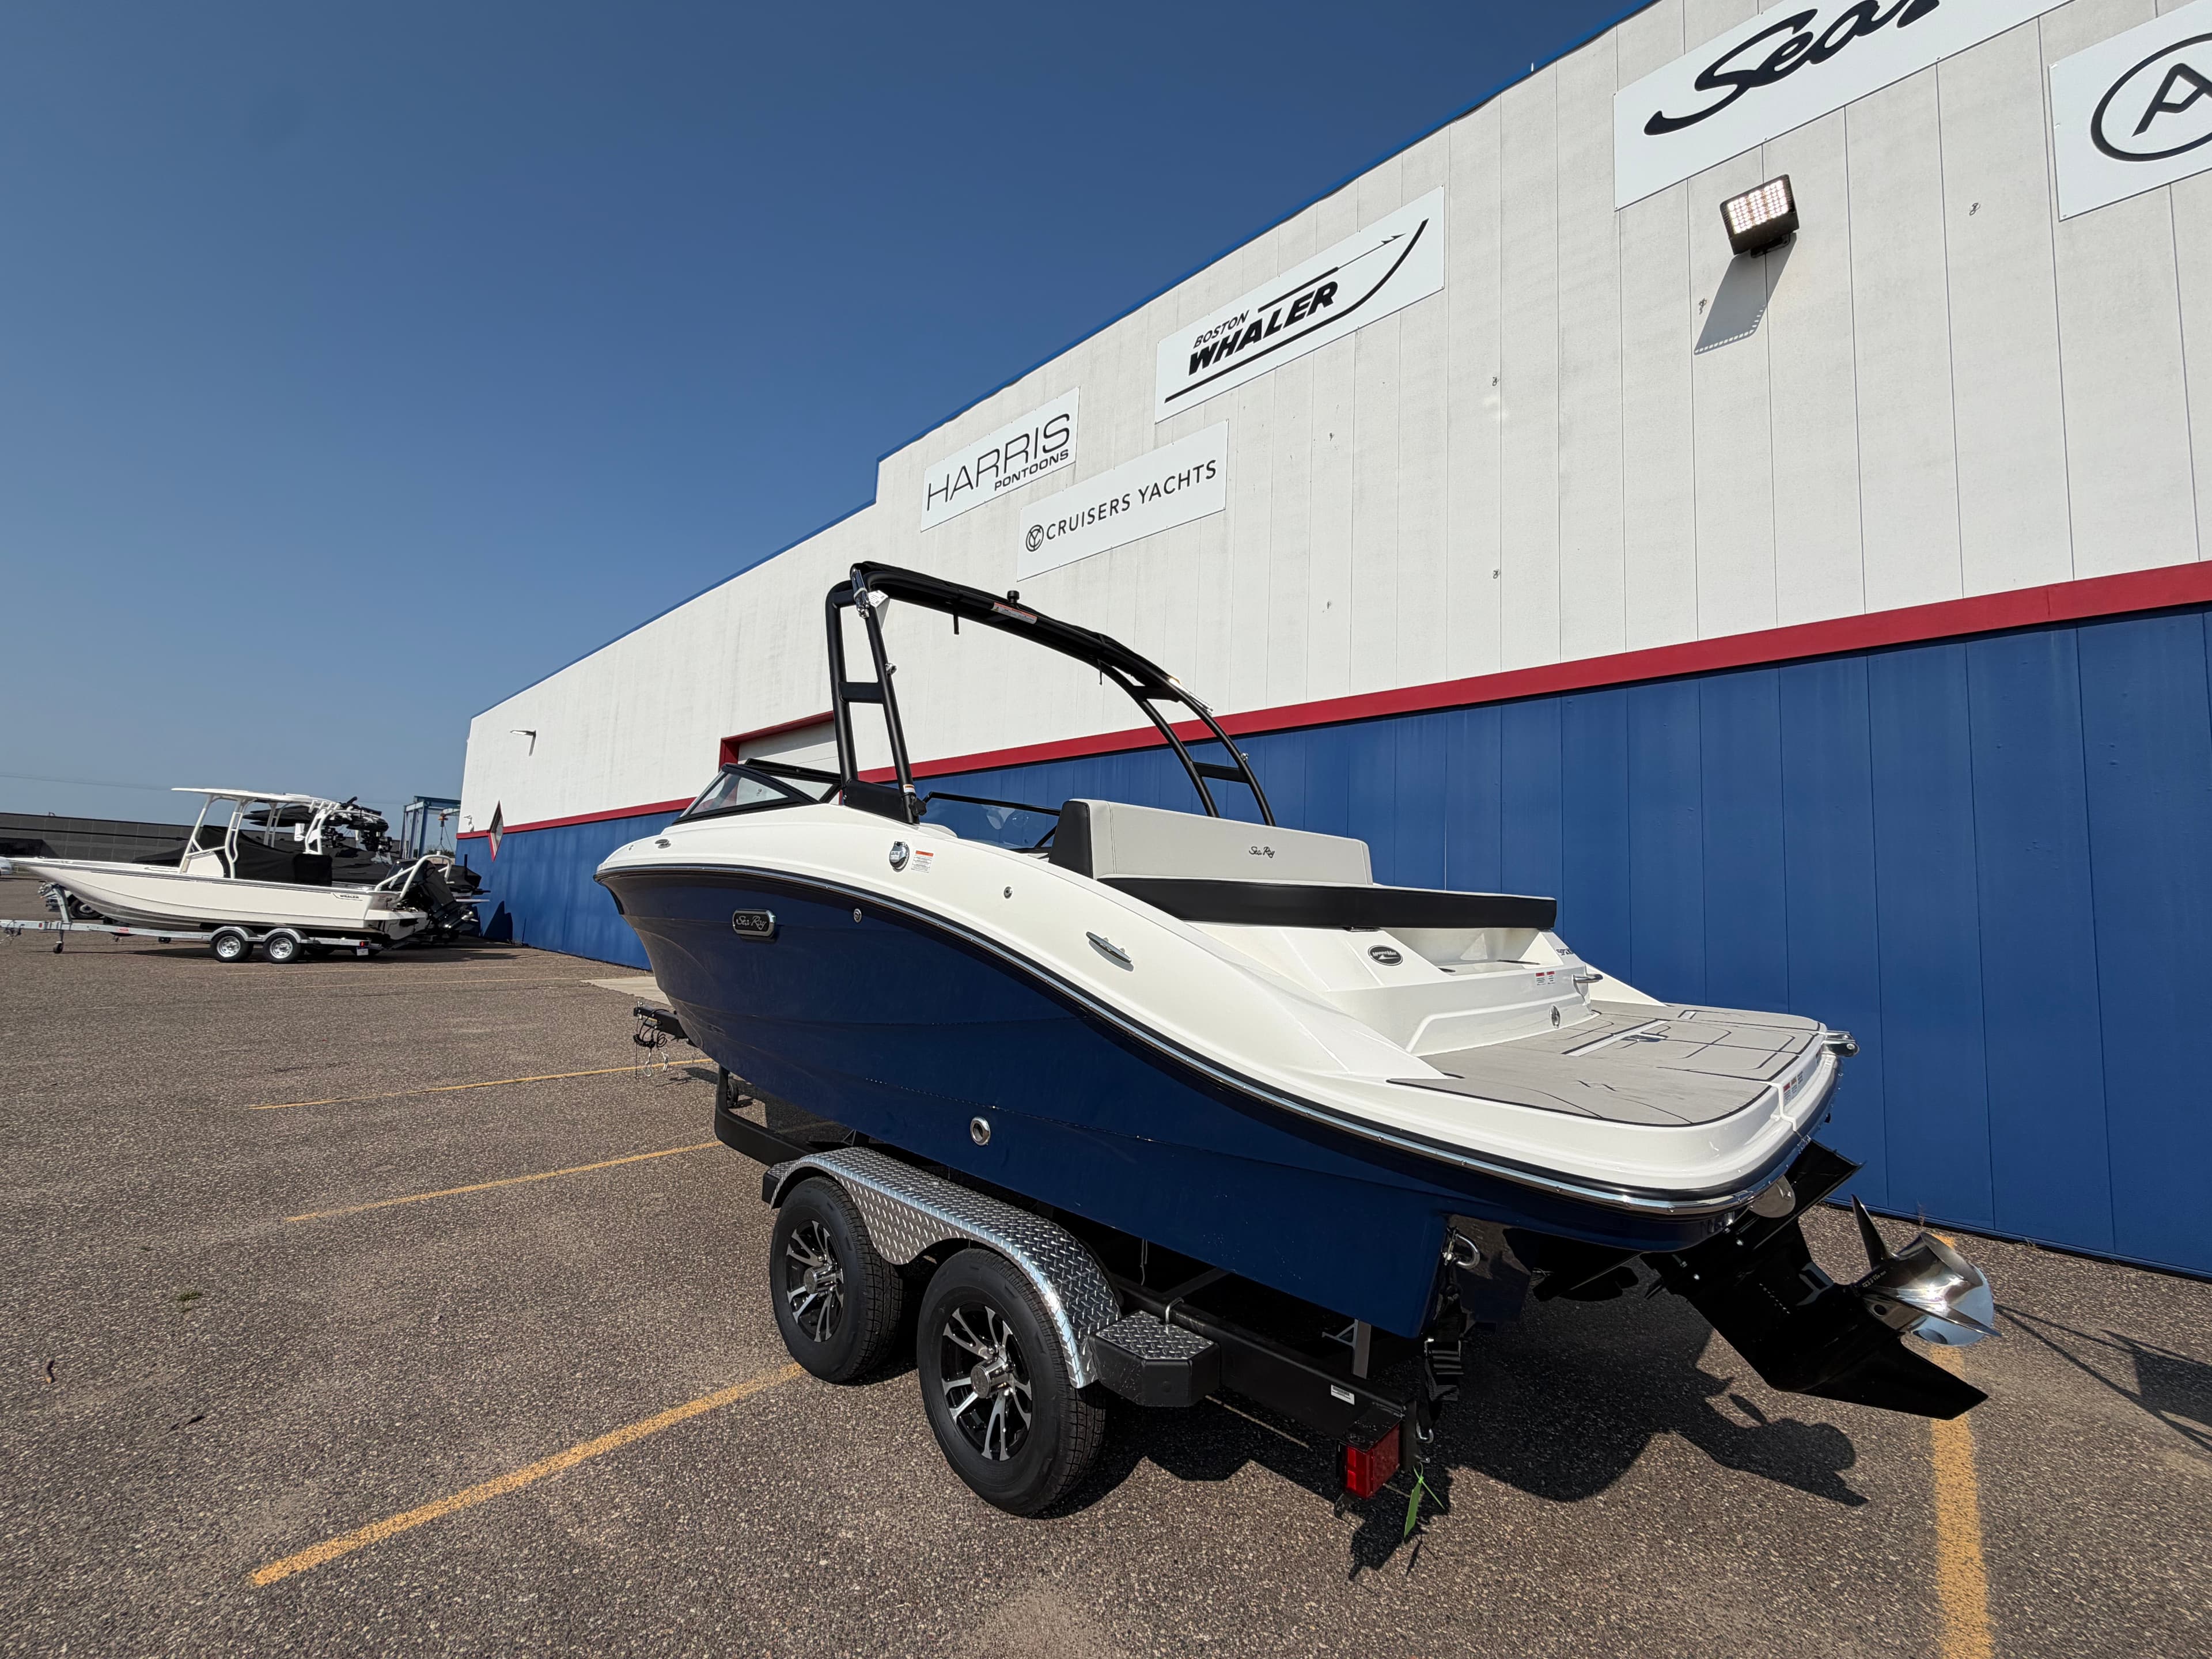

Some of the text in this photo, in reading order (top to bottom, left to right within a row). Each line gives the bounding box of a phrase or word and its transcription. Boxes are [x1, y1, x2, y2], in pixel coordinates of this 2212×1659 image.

[1643, 0, 1910, 135] Sea
[1188, 281, 1338, 376] WHALER
[1193, 310, 1249, 349] BOSTON
[926, 414, 1070, 512] HARRIS
[994, 449, 1069, 491] PONTOONS
[1046, 493, 1131, 540] CRUISERS
[1138, 460, 1217, 505] YACHTS
[1248, 846, 1275, 858] Sea Ray
[736, 915, 767, 930] Sea Ray
